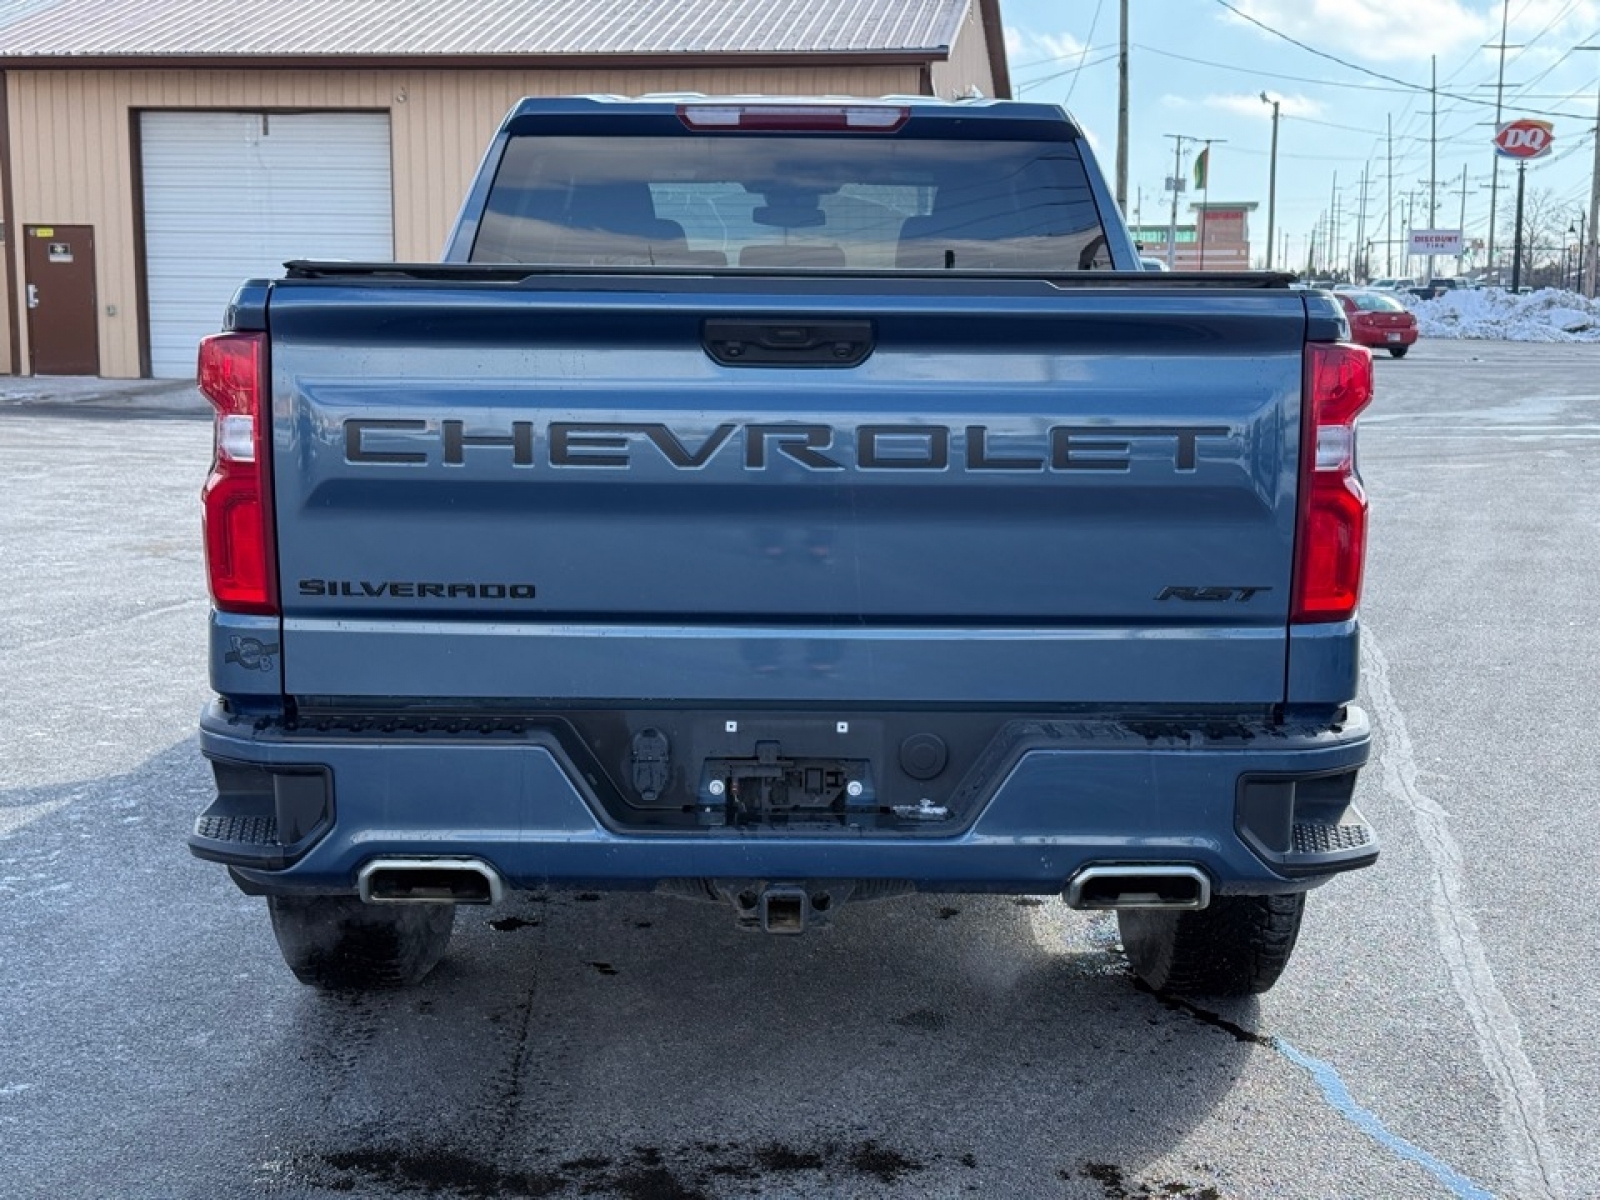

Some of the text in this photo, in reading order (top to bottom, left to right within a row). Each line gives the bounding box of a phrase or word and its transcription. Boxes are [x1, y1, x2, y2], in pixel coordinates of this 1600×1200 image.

[1505, 128, 1546, 150] DQ
[1414, 235, 1458, 243] DISCOUNT
[343, 418, 1232, 473] CHEVROLET
[299, 579, 536, 599] SILVERADO
[1153, 586, 1273, 602] RST
